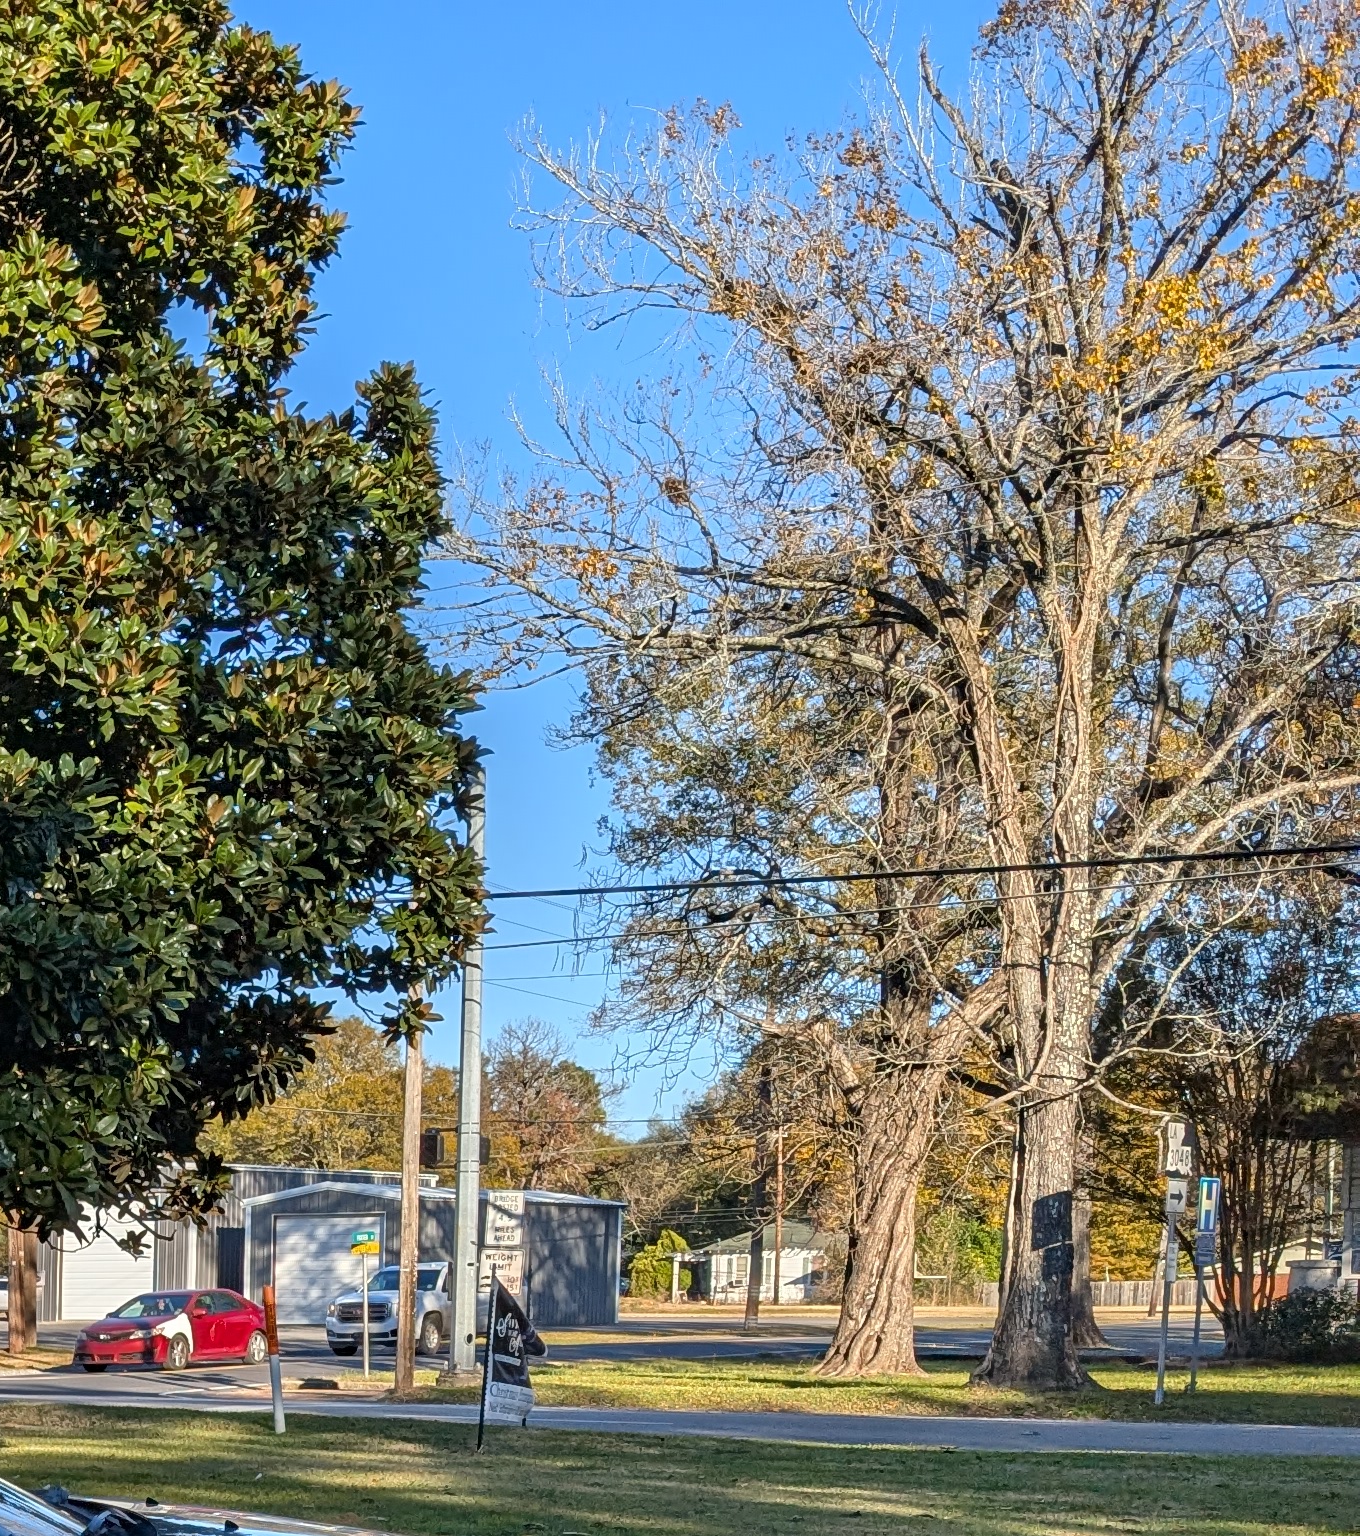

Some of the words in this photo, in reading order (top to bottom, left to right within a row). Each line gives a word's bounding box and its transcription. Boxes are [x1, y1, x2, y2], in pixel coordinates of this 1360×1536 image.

[1169, 1123, 1178, 1140] LA
[1169, 1149, 1190, 1167] 3048
[494, 1195, 519, 1203] BRIDGE
[1200, 1182, 1218, 1230] H
[493, 1234, 516, 1242] AHEAD
[485, 1253, 519, 1262] WEIGHT
[489, 1262, 513, 1271] LMIT
